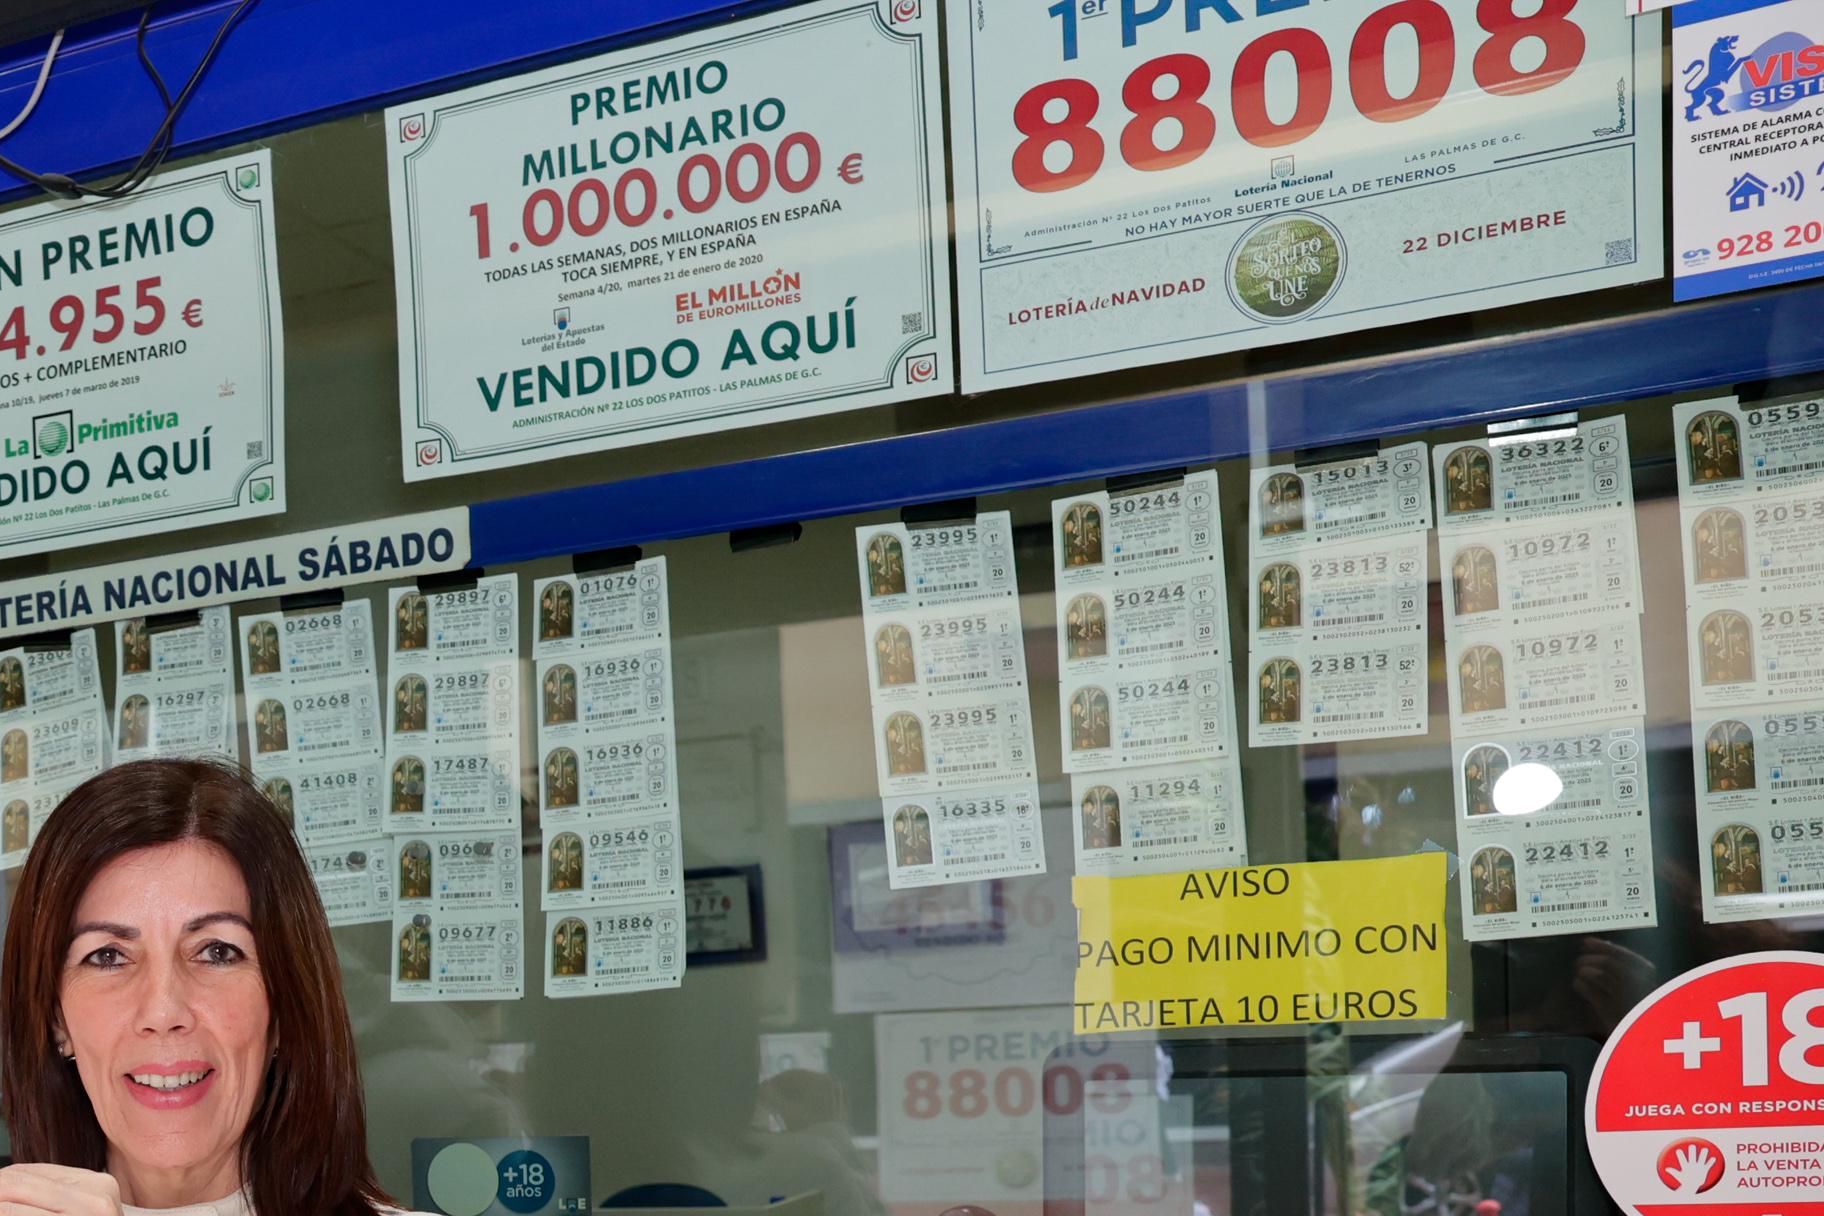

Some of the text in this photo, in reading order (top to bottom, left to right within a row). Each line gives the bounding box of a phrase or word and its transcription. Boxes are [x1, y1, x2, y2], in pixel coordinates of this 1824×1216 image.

[571, 61, 727, 125] PREMIO
[1012, 0, 1586, 194] 88008
[523, 98, 785, 186] MILLONARIO
[470, 132, 864, 259] 1.000.000 €
[1281, 170, 1332, 188] Nacional
[1125, 164, 1457, 238] NO HAY MAYOR SUERTE QUE LA DE TENERNOS
[43, 207, 213, 280] PREMIO
[484, 199, 841, 282] TODAS LAS SEMANAS, DOS MILLONARIOS EN ESPAÑA
[1403, 211, 1566, 253] 22 DICIEMBRE
[1718, 221, 1824, 259] 928 20
[562, 234, 756, 282] TOCA SIEMPRE, Y EN ESPAÑA
[182, 299, 203, 328] €
[676, 292, 702, 312] EL
[677, 293, 801, 324] DE EUROMILLONES
[1009, 298, 1087, 325] LOTERÍA
[1112, 278, 1205, 306] NAVIDAD
[37, 340, 186, 381] COMPLEMENTARIO
[478, 296, 856, 411] VENDIDO AQUÍ
[5, 410, 178, 457] La Primitiva
[1503, 436, 1583, 460] 36322
[107, 426, 211, 488] AQUÍ
[1312, 461, 1388, 485] 15013
[1109, 492, 1180, 517] 50244
[912, 528, 976, 549] 23995
[1510, 533, 1589, 560] 10972
[104, 555, 286, 611] NACIONAL
[298, 527, 455, 578] SÁBADO
[286, 615, 341, 633] 02668
[435, 758, 488, 772] 17487
[1526, 841, 1608, 864] 22412
[1180, 862, 1293, 900] AVISO
[440, 926, 496, 942] 09677
[597, 917, 652, 933] 11886
[1076, 923, 1436, 970] PAGO MINIMO CON
[1074, 988, 1419, 1031] TARJETA 10 EUROS
[1664, 988, 1824, 1086] +18
[1626, 1105, 1685, 1117] JUEGA
[1692, 1103, 1733, 1115] CON
[503, 1164, 545, 1185] +18
[1737, 1159, 1821, 1171] LA VENTA
[1737, 1176, 1824, 1187] AUTOPRO
[507, 1184, 543, 1198] años
